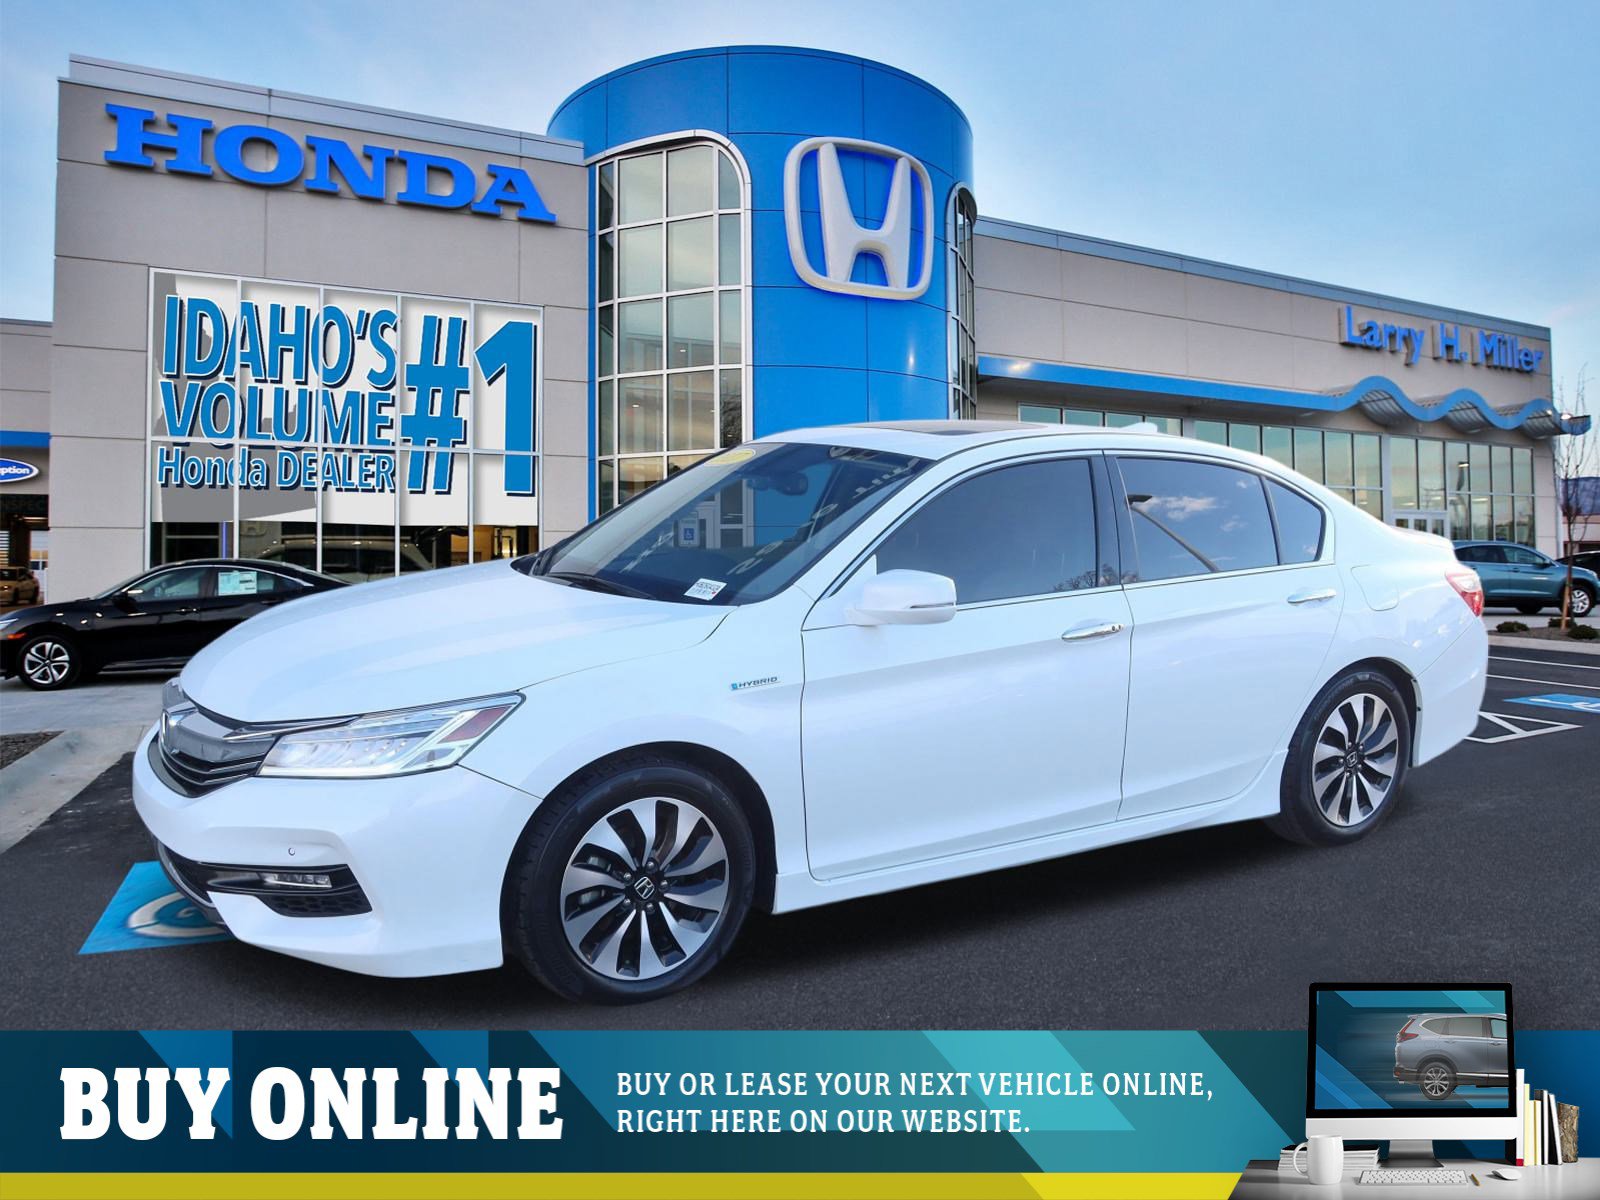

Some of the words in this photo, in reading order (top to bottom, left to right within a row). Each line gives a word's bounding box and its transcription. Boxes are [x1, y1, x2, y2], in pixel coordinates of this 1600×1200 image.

[105, 103, 557, 224] HONDA
[163, 295, 399, 389] IDAHO'S
[1345, 305, 1424, 366] Larry
[1440, 322, 1468, 363] H.
[1479, 329, 1544, 372] Miller
[160, 381, 396, 447] VOLUME
[400, 314, 536, 496] #1
[157, 446, 267, 489] Honda
[276, 451, 396, 492] DEALER
[738, 676, 778, 688] HYBRID
